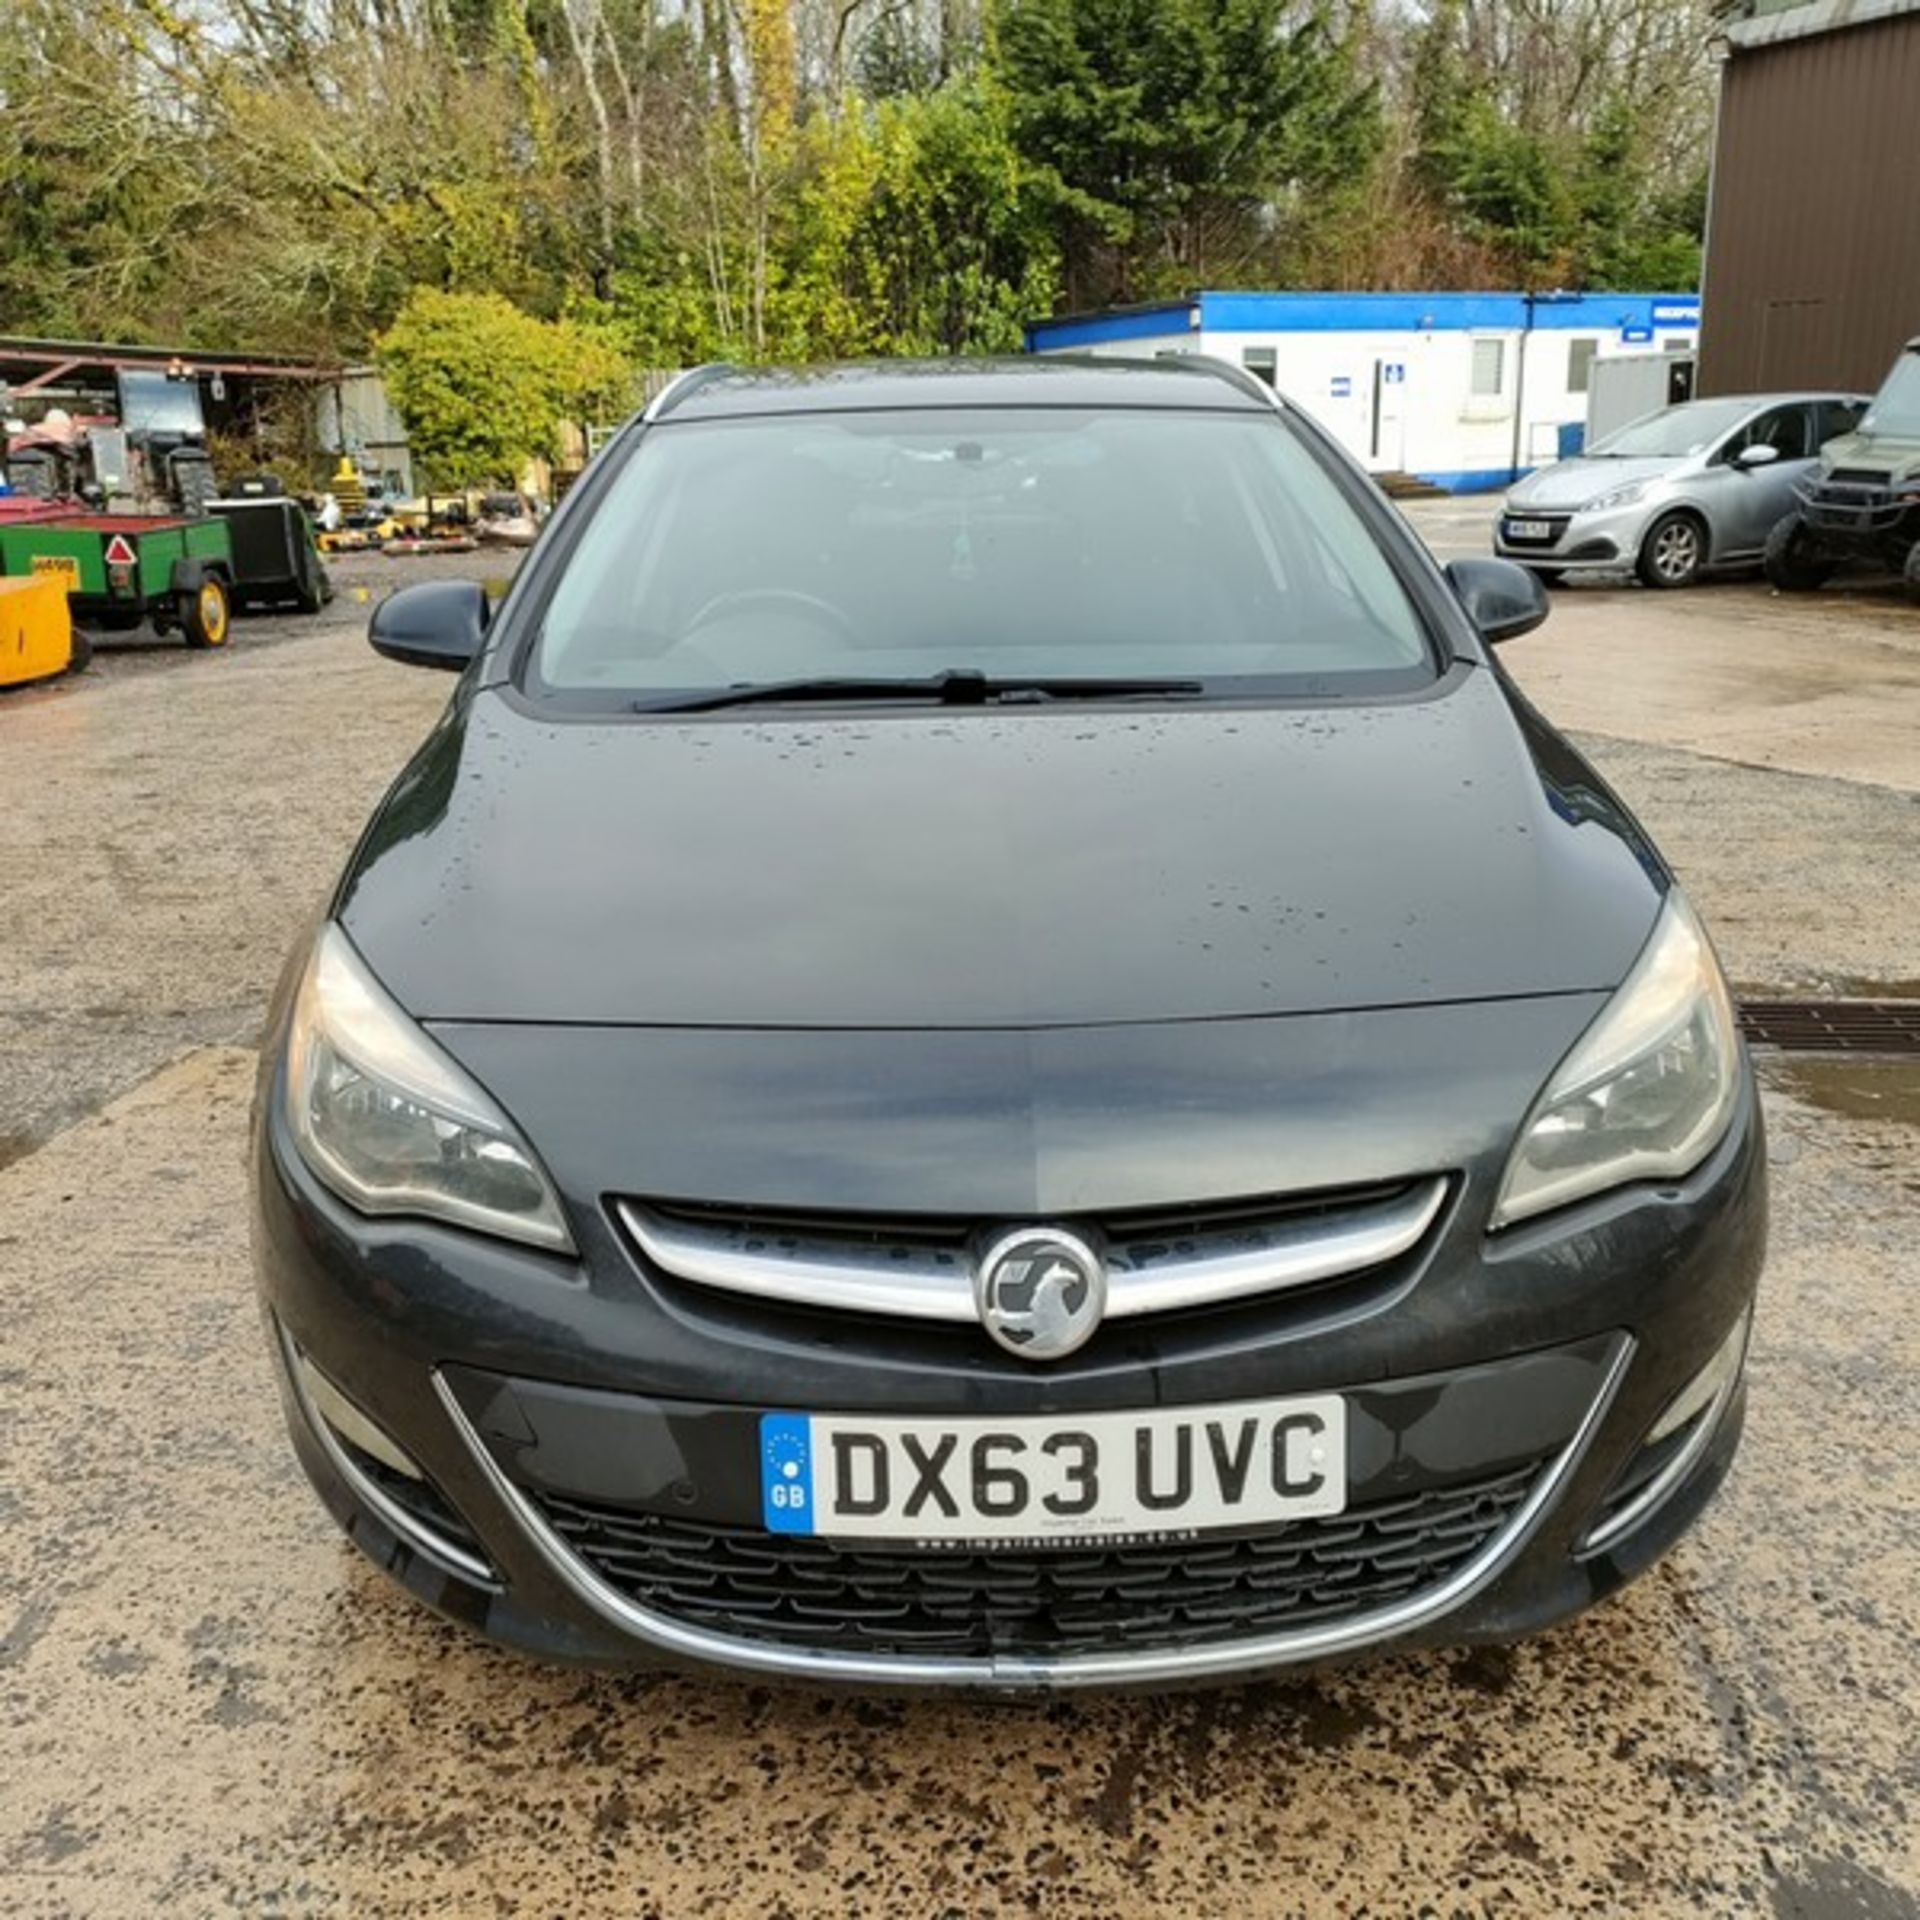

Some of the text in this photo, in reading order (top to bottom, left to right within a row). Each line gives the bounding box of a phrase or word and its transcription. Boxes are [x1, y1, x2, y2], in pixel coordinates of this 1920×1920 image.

[770, 1483, 806, 1509] GB
[831, 1413, 1325, 1517] DX63 UVC
